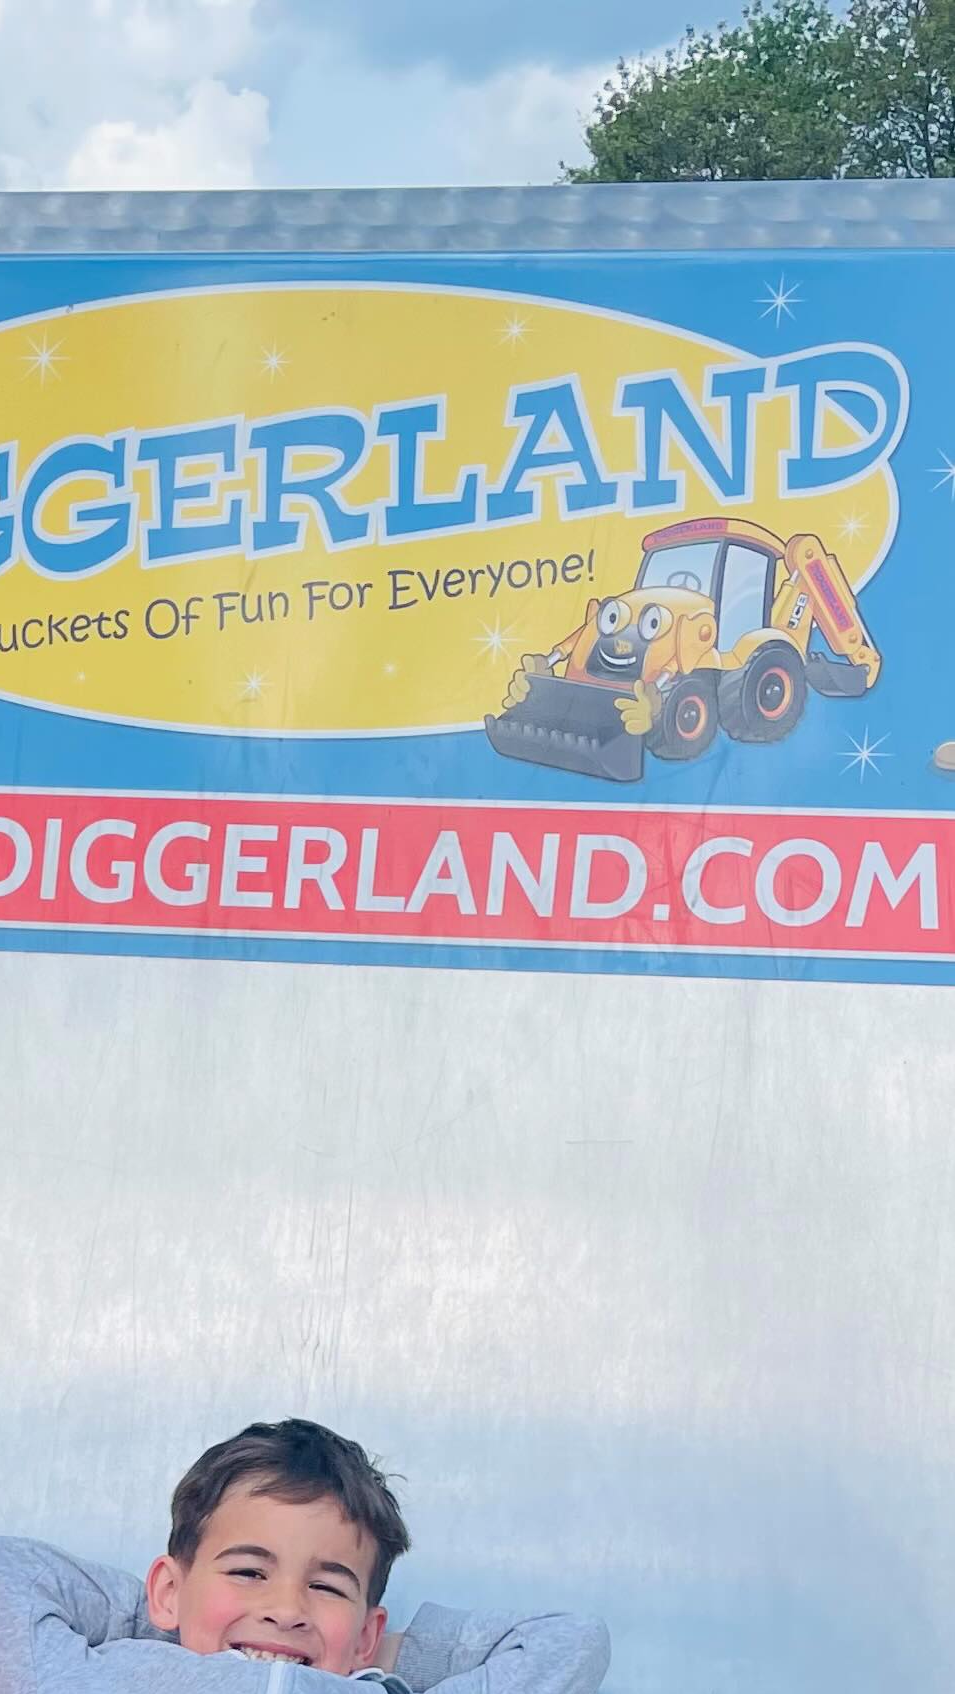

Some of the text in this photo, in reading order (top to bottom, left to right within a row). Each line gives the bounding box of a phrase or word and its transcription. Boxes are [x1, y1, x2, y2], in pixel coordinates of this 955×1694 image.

[653, 521, 724, 541] ERLAND
[144, 595, 204, 640] Of
[216, 582, 290, 632] Fun
[302, 578, 373, 621] For
[387, 549, 596, 610] Everyone!
[788, 592, 808, 628] JCB
